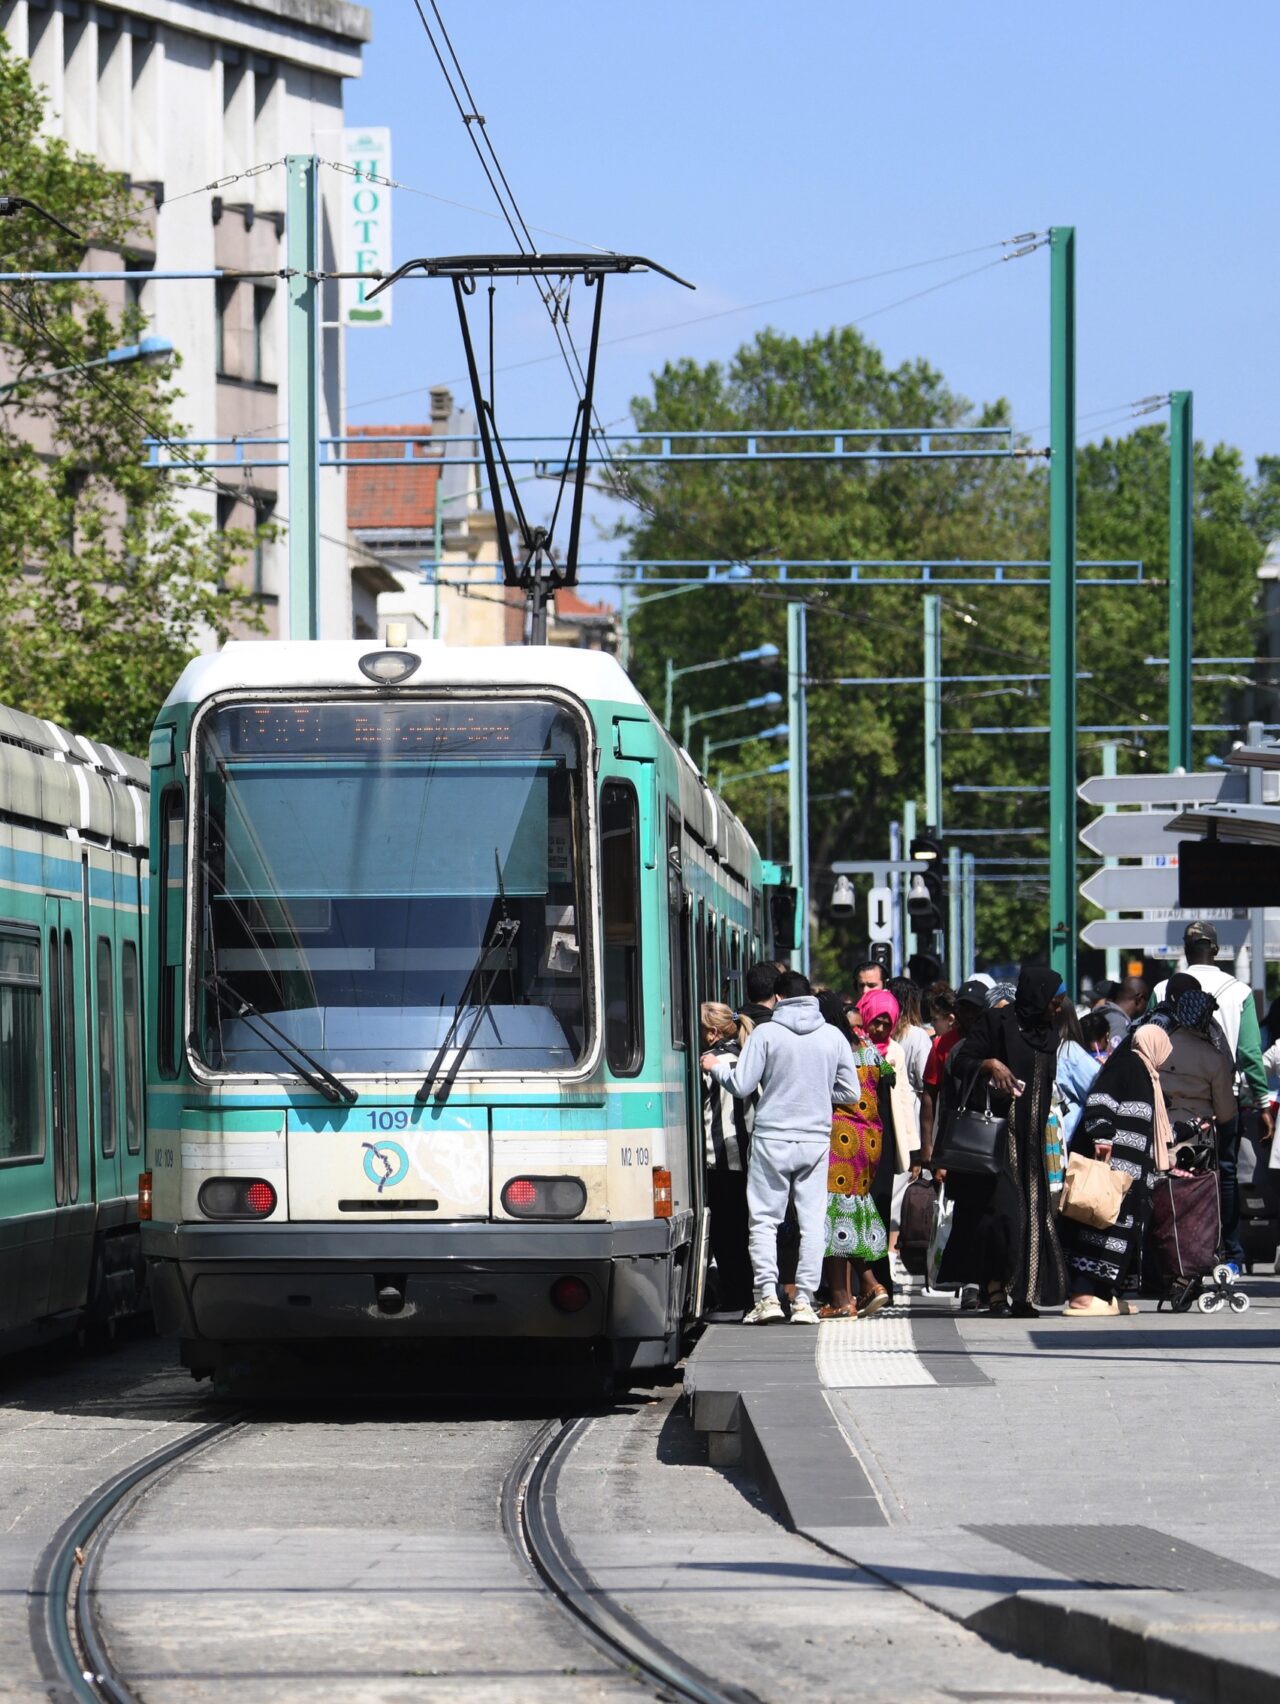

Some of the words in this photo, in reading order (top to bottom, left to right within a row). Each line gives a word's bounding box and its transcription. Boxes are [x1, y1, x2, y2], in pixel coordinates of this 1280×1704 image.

[353, 159, 379, 304] HOTEL
[366, 1110, 408, 1130] 109
[621, 1147, 632, 1167] M2
[636, 1147, 649, 1167] 109
